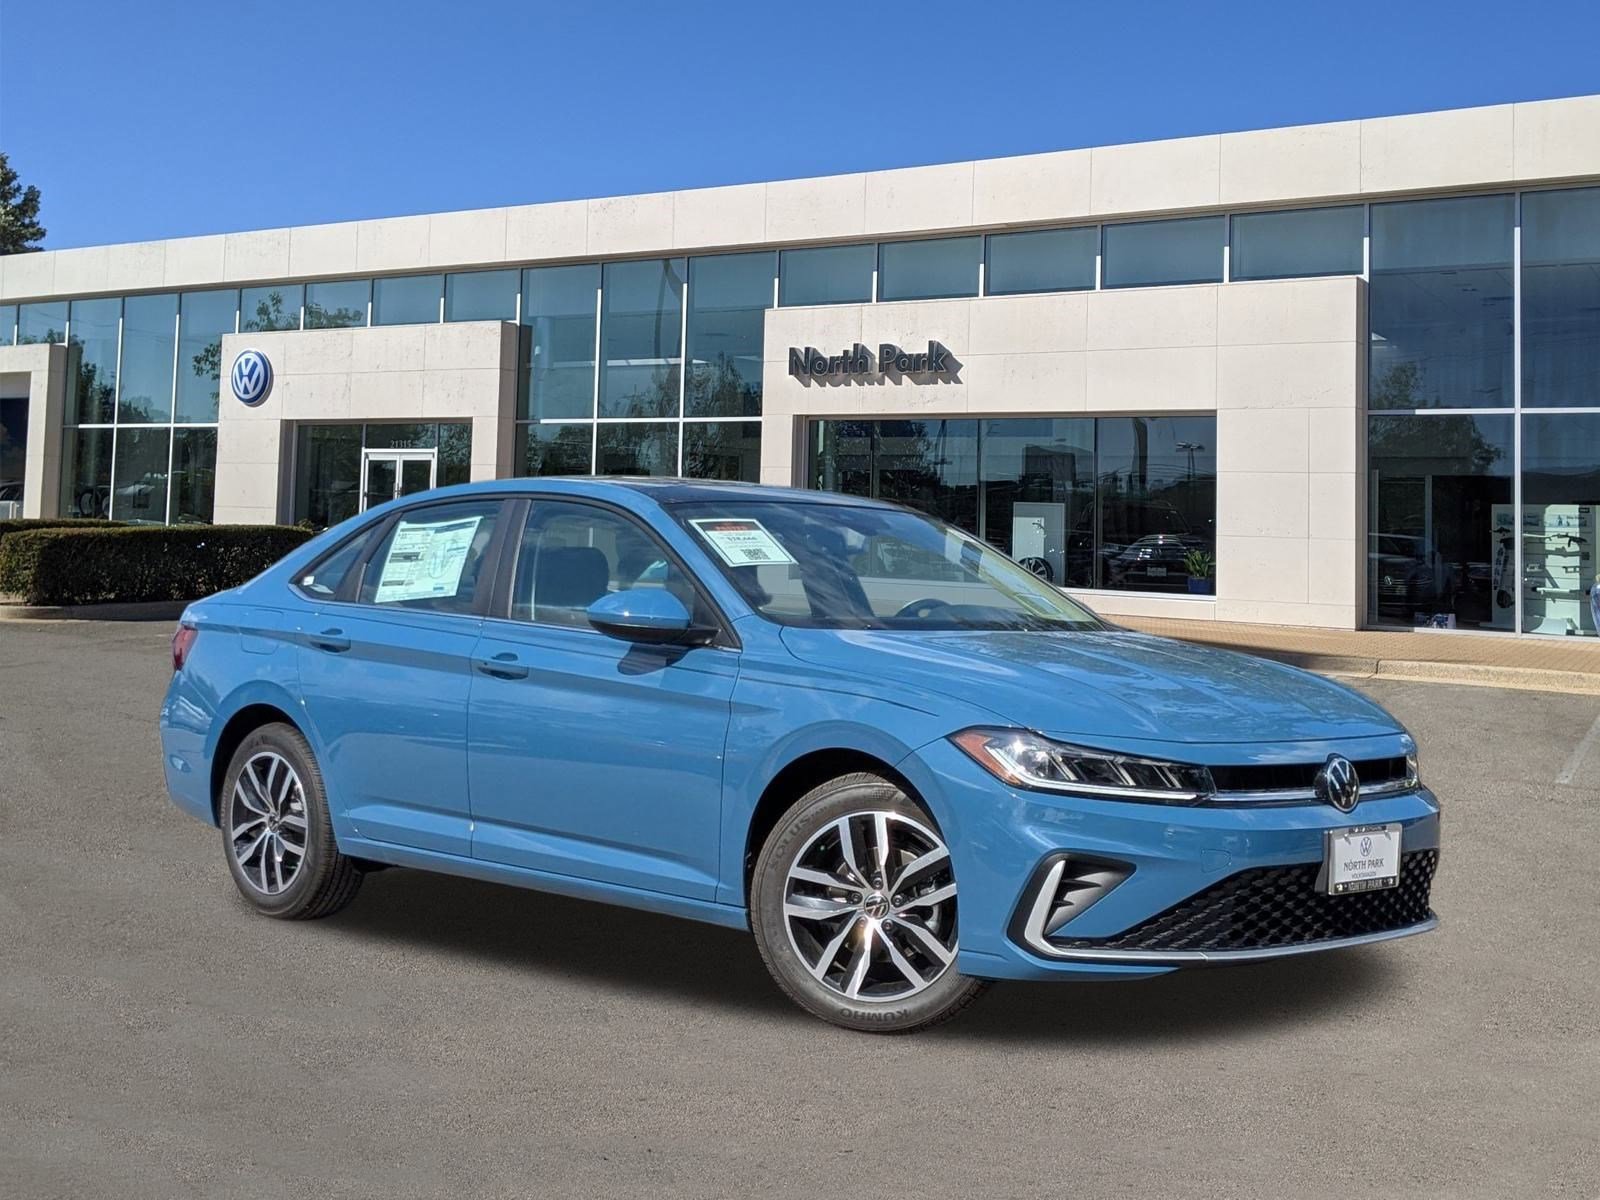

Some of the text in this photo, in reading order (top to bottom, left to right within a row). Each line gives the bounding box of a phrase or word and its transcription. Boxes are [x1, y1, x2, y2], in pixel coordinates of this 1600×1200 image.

[788, 340, 948, 376] North Park
[1344, 858, 1385, 872] NORTH PARK
[840, 1007, 912, 1022] KUMHO
